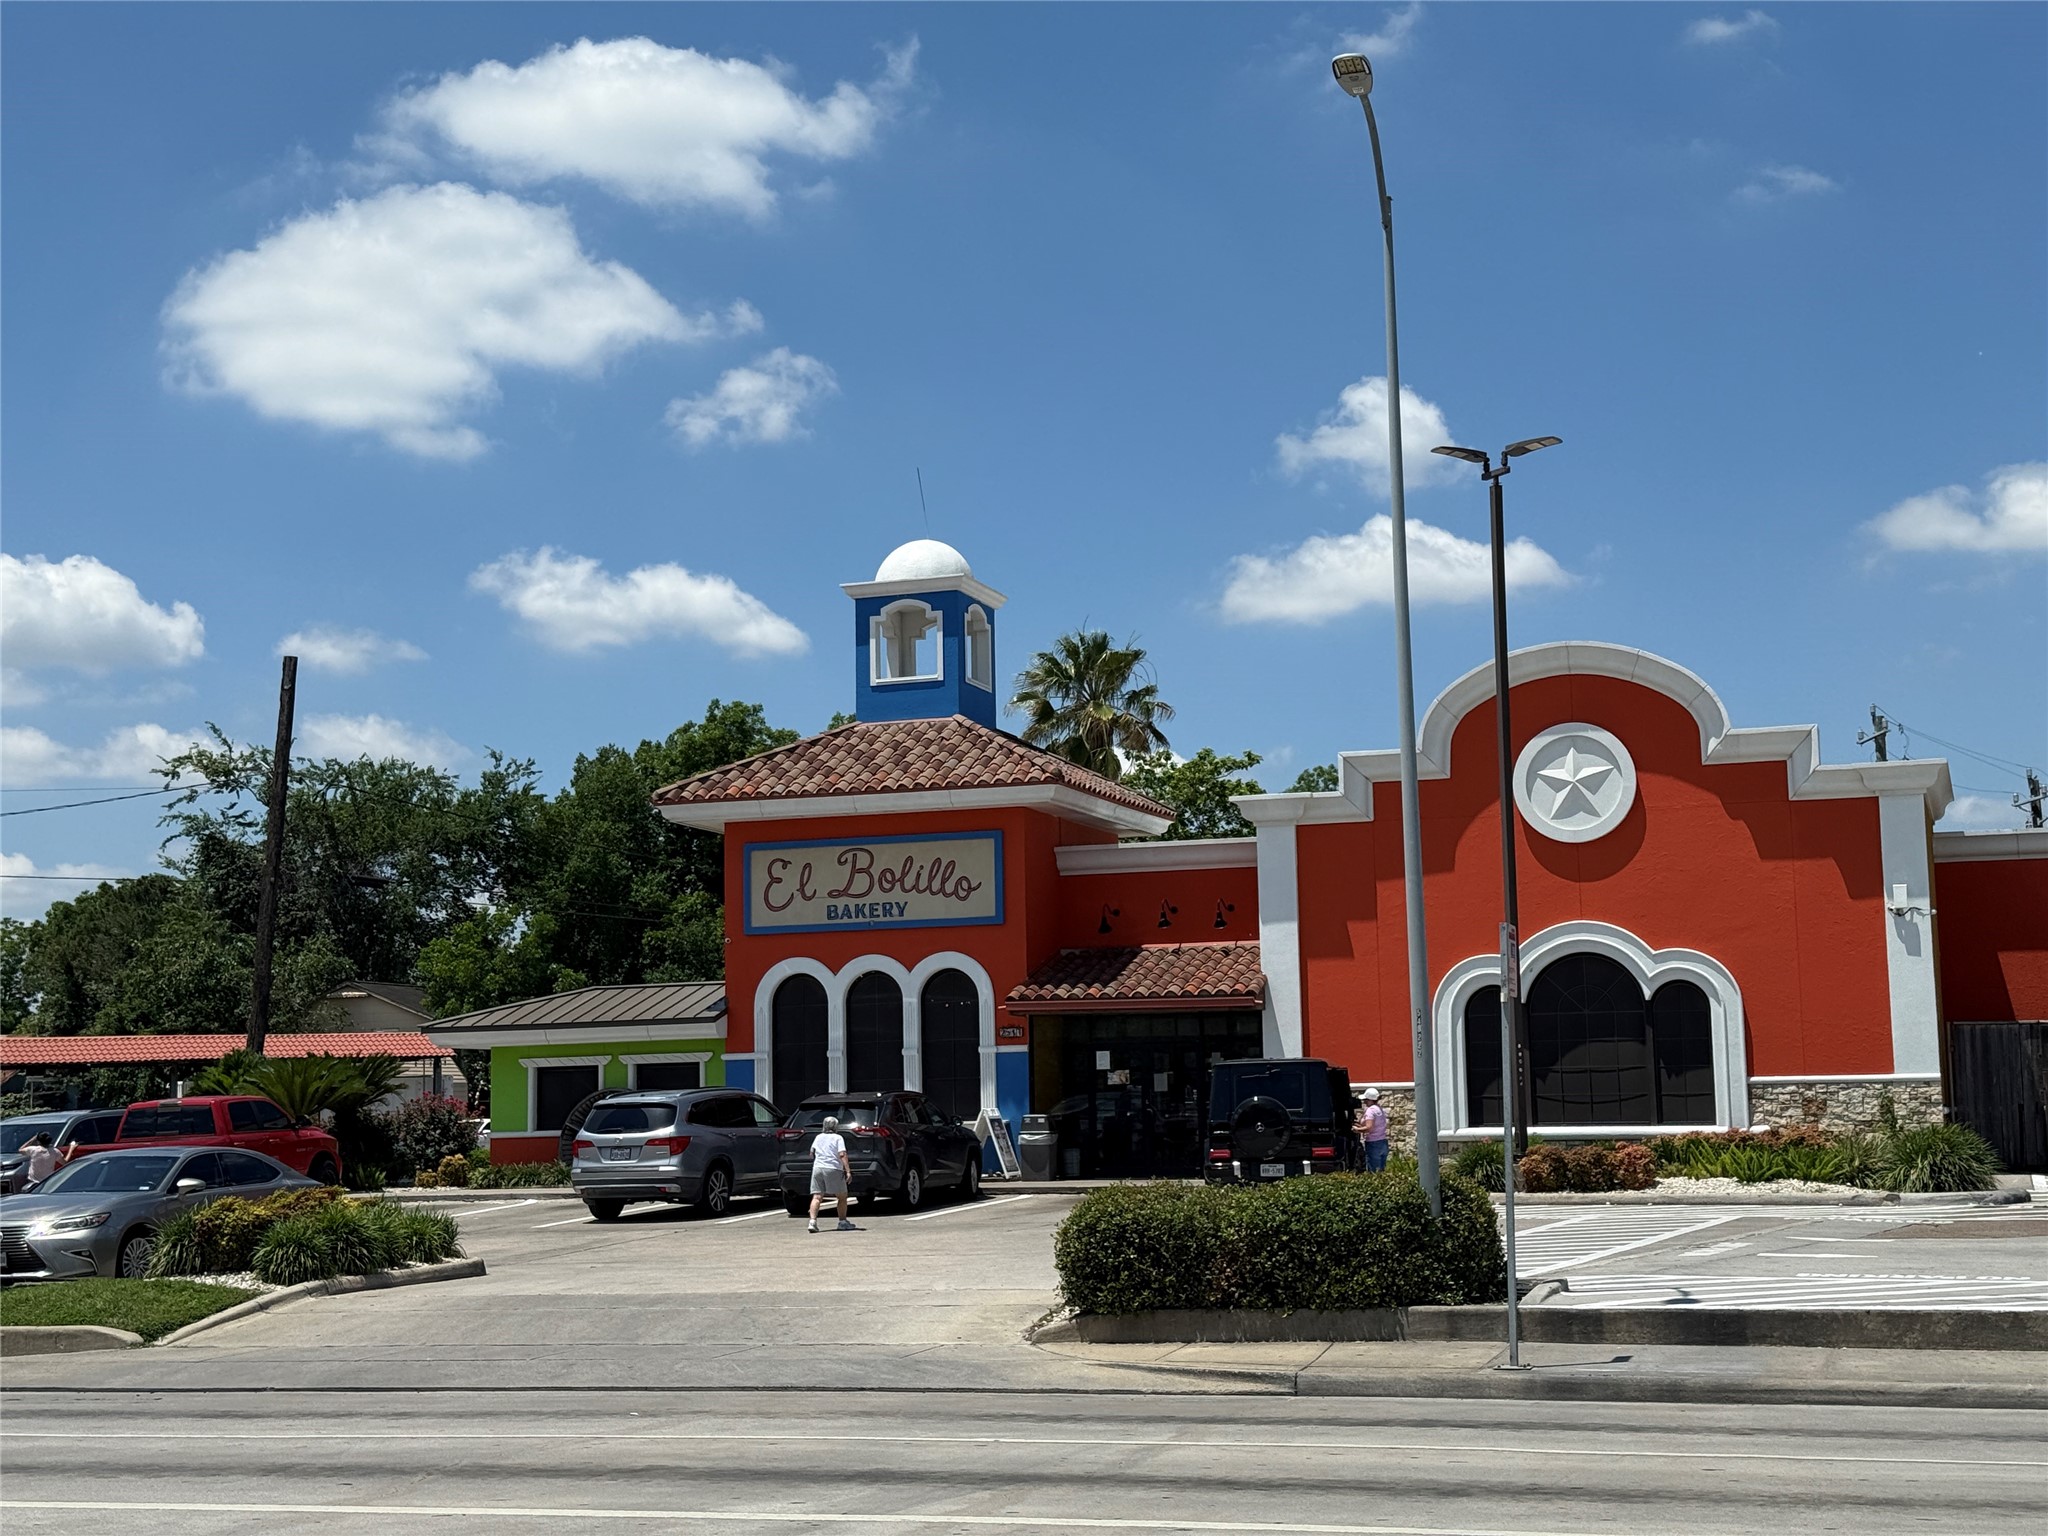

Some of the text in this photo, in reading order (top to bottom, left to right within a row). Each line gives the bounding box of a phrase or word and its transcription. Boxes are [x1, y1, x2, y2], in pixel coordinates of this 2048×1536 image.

[763, 847, 982, 912] El Bolillo
[826, 901, 908, 920] BAKERY
